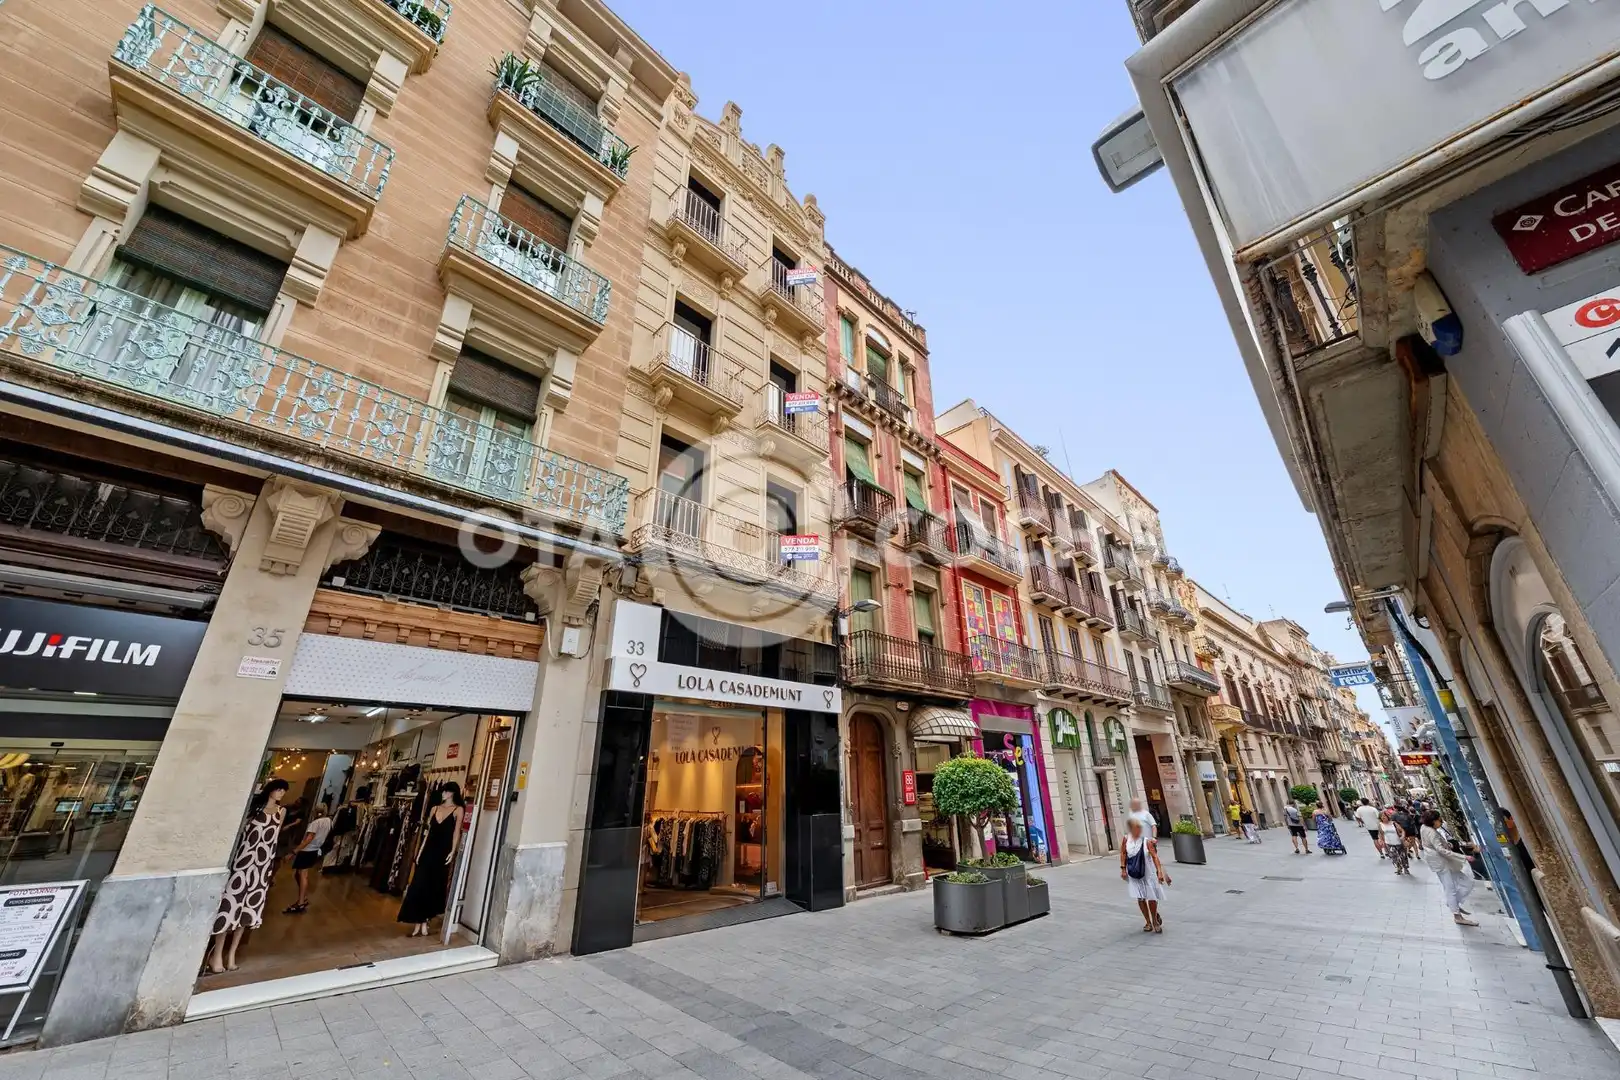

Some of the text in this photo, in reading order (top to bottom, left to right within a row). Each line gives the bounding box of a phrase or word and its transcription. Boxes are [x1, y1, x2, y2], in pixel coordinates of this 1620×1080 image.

[785, 537, 816, 545] VENDA
[247, 626, 286, 648] 35
[626, 640, 644, 655] 33
[1339, 674, 1370, 685] reus
[678, 674, 802, 702] LOLA CASADEMUNT
[675, 750, 696, 764] LOLA
